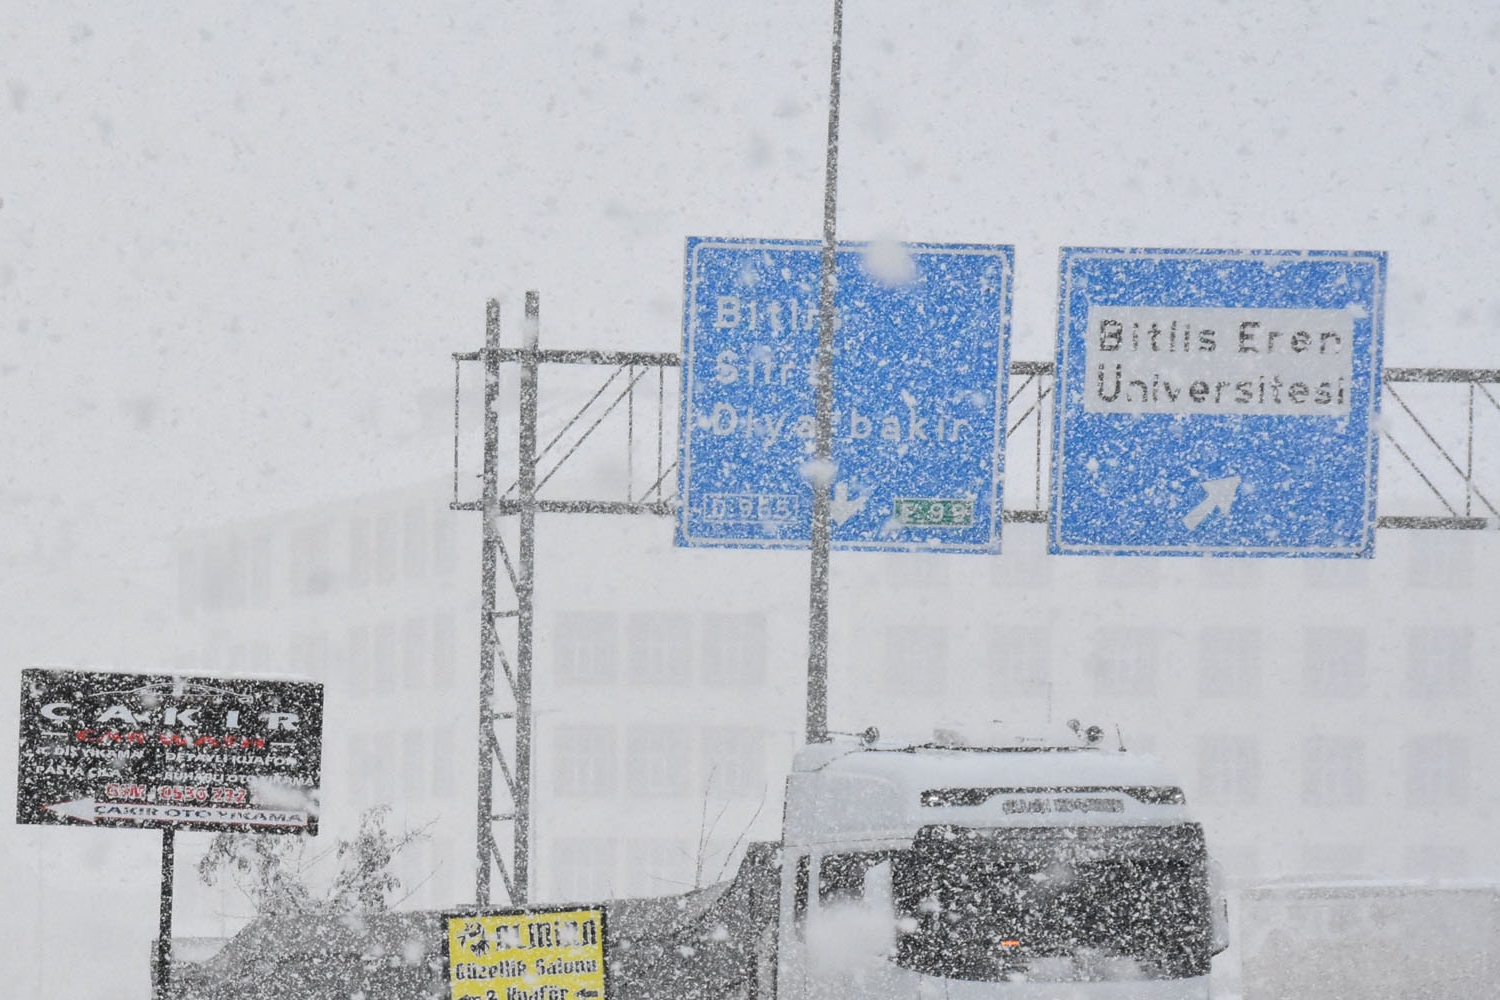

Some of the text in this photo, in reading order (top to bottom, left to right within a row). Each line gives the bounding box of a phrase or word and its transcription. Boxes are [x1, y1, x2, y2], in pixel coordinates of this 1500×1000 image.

[1100, 319, 1343, 353] Bitlis Eren
[165, 807, 212, 819] OTO
